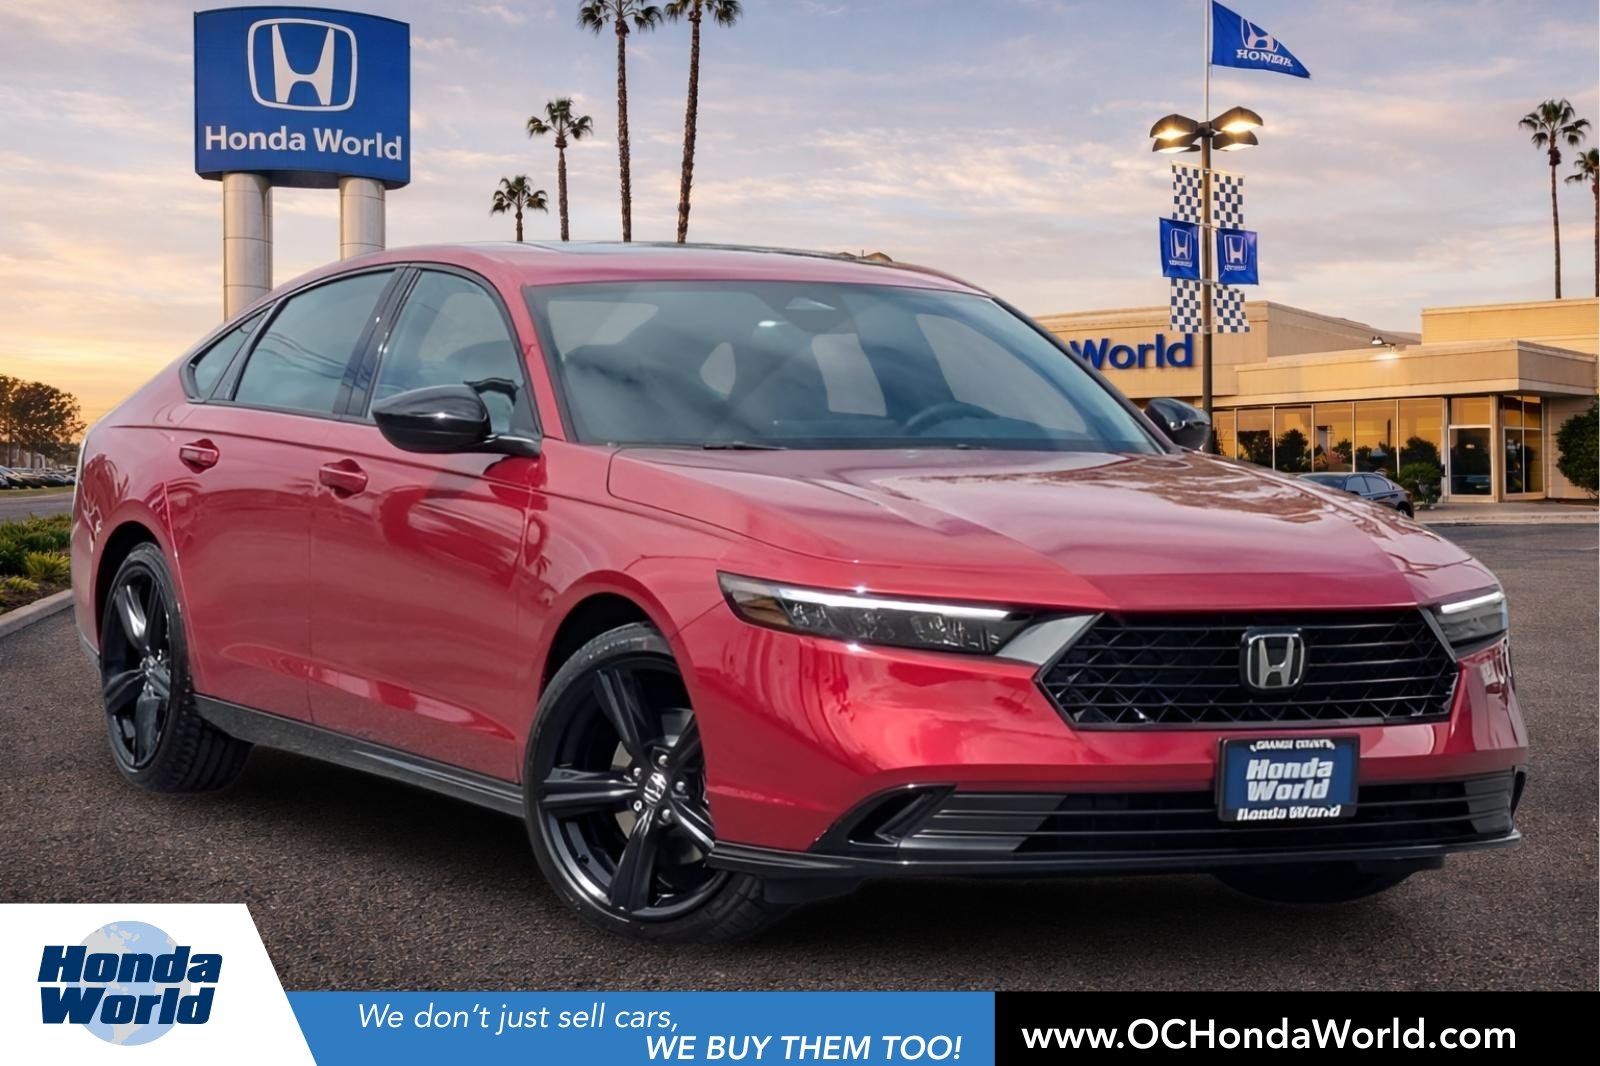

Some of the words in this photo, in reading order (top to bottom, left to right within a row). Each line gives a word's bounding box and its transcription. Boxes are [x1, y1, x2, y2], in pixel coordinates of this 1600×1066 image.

[205, 125, 306, 151] Honda
[313, 127, 402, 160] World
[1069, 333, 1193, 370] World
[1246, 757, 1334, 780] Honda
[1247, 778, 1330, 801] World
